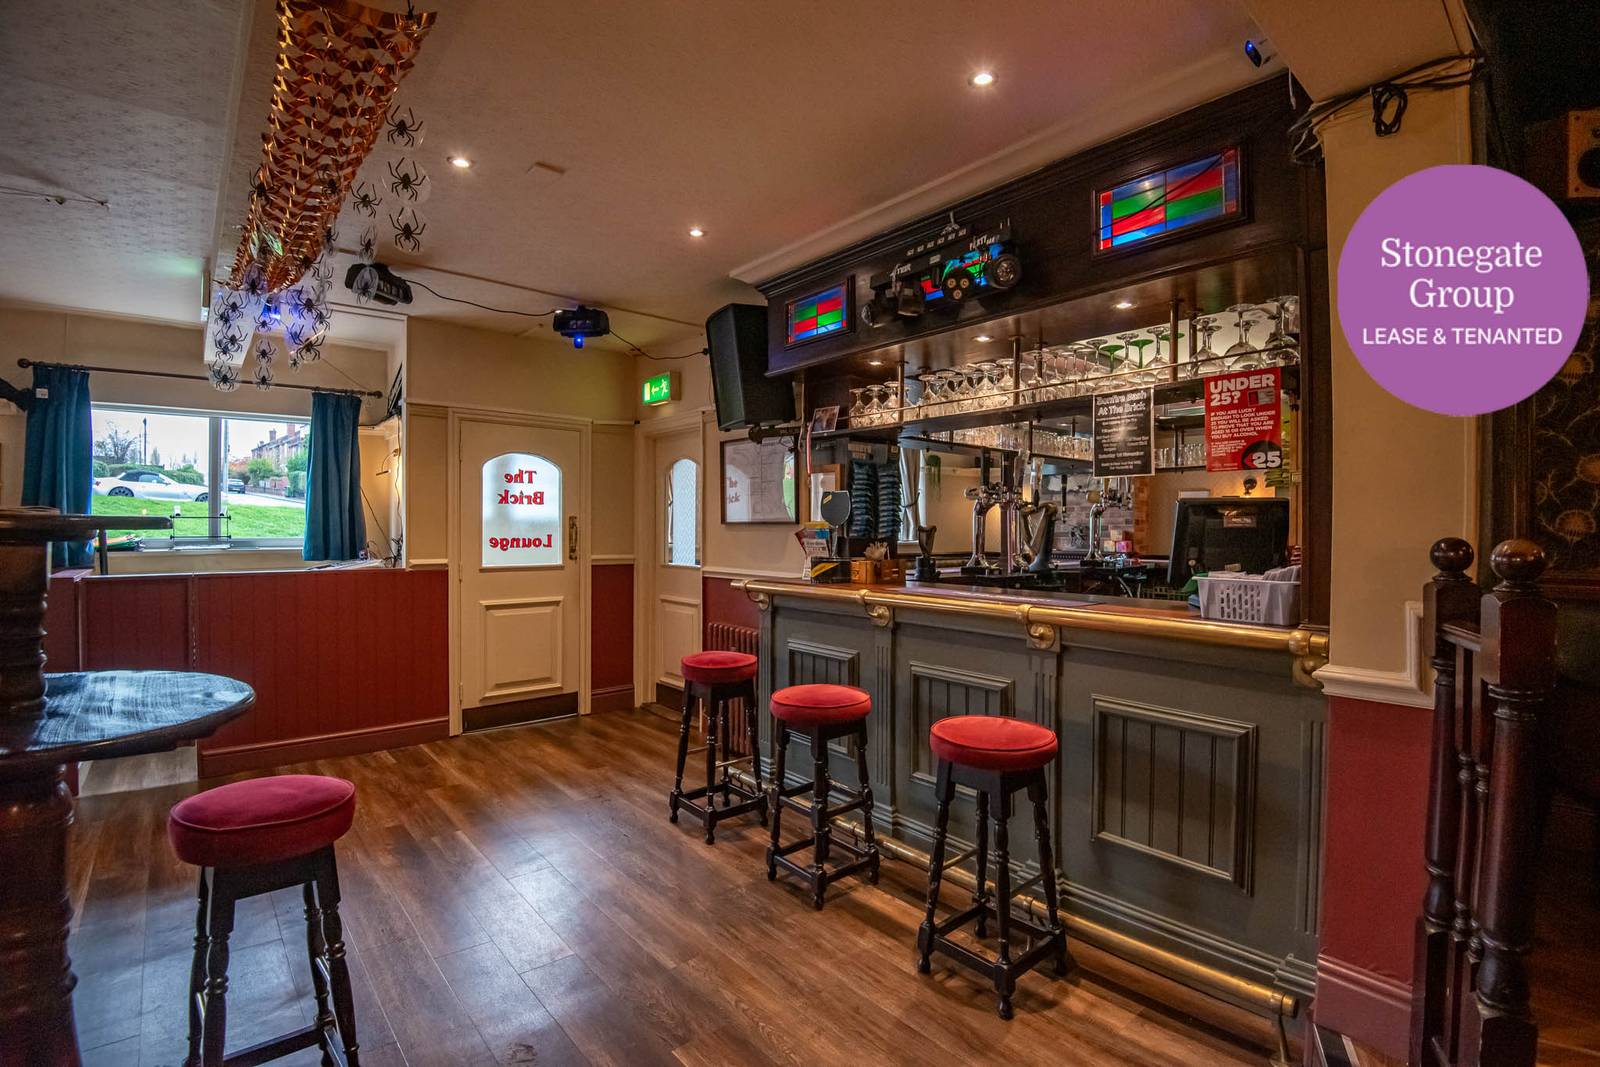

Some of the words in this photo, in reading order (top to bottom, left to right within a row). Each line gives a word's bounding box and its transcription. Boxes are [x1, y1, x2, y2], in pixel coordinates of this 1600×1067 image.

[1210, 374, 1275, 394] UNDER
[1210, 391, 1241, 407] 25?
[1098, 406, 1108, 416] At
[1109, 405, 1123, 415] The
[1124, 402, 1146, 413] Brick
[1252, 451, 1281, 468] 25
